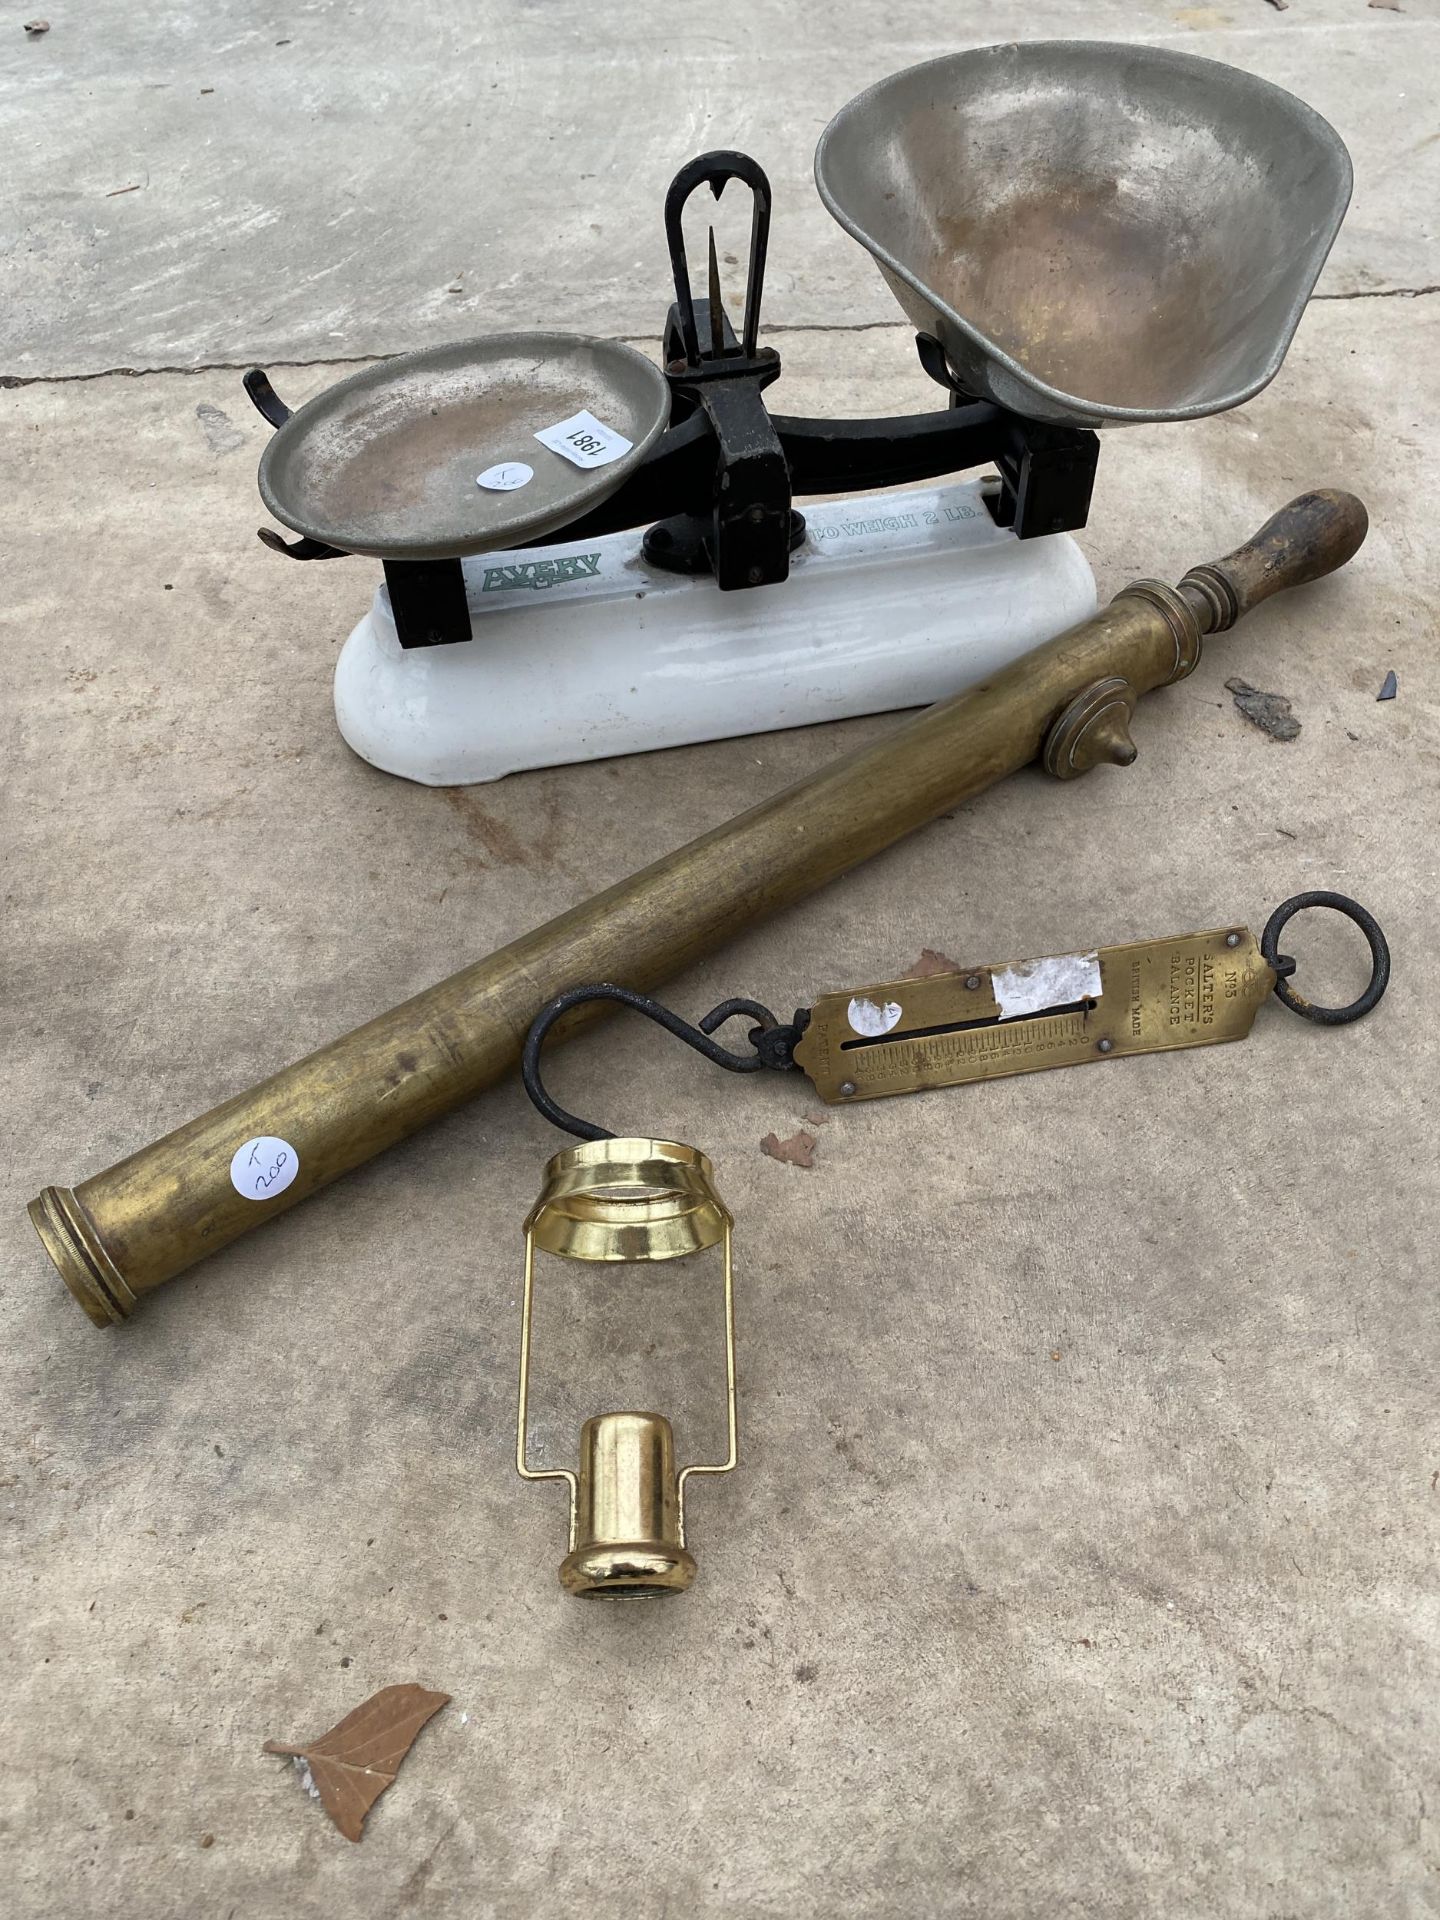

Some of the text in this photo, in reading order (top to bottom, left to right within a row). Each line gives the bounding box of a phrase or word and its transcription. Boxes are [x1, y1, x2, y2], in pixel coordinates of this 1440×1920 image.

[566, 429, 607, 456] 1981
[809, 526, 839, 541] TO
[842, 513, 918, 536] WEIGH
[923, 511, 939, 525] 2
[482, 553, 601, 591] AVERY
[1131, 961, 1142, 1037] BRITISH MADE
[1170, 955, 1181, 1026] BALANCE
[1184, 957, 1195, 1022] POCKET
[1203, 953, 1214, 1025] SALTER'S
[255, 1152, 287, 1191] 200
